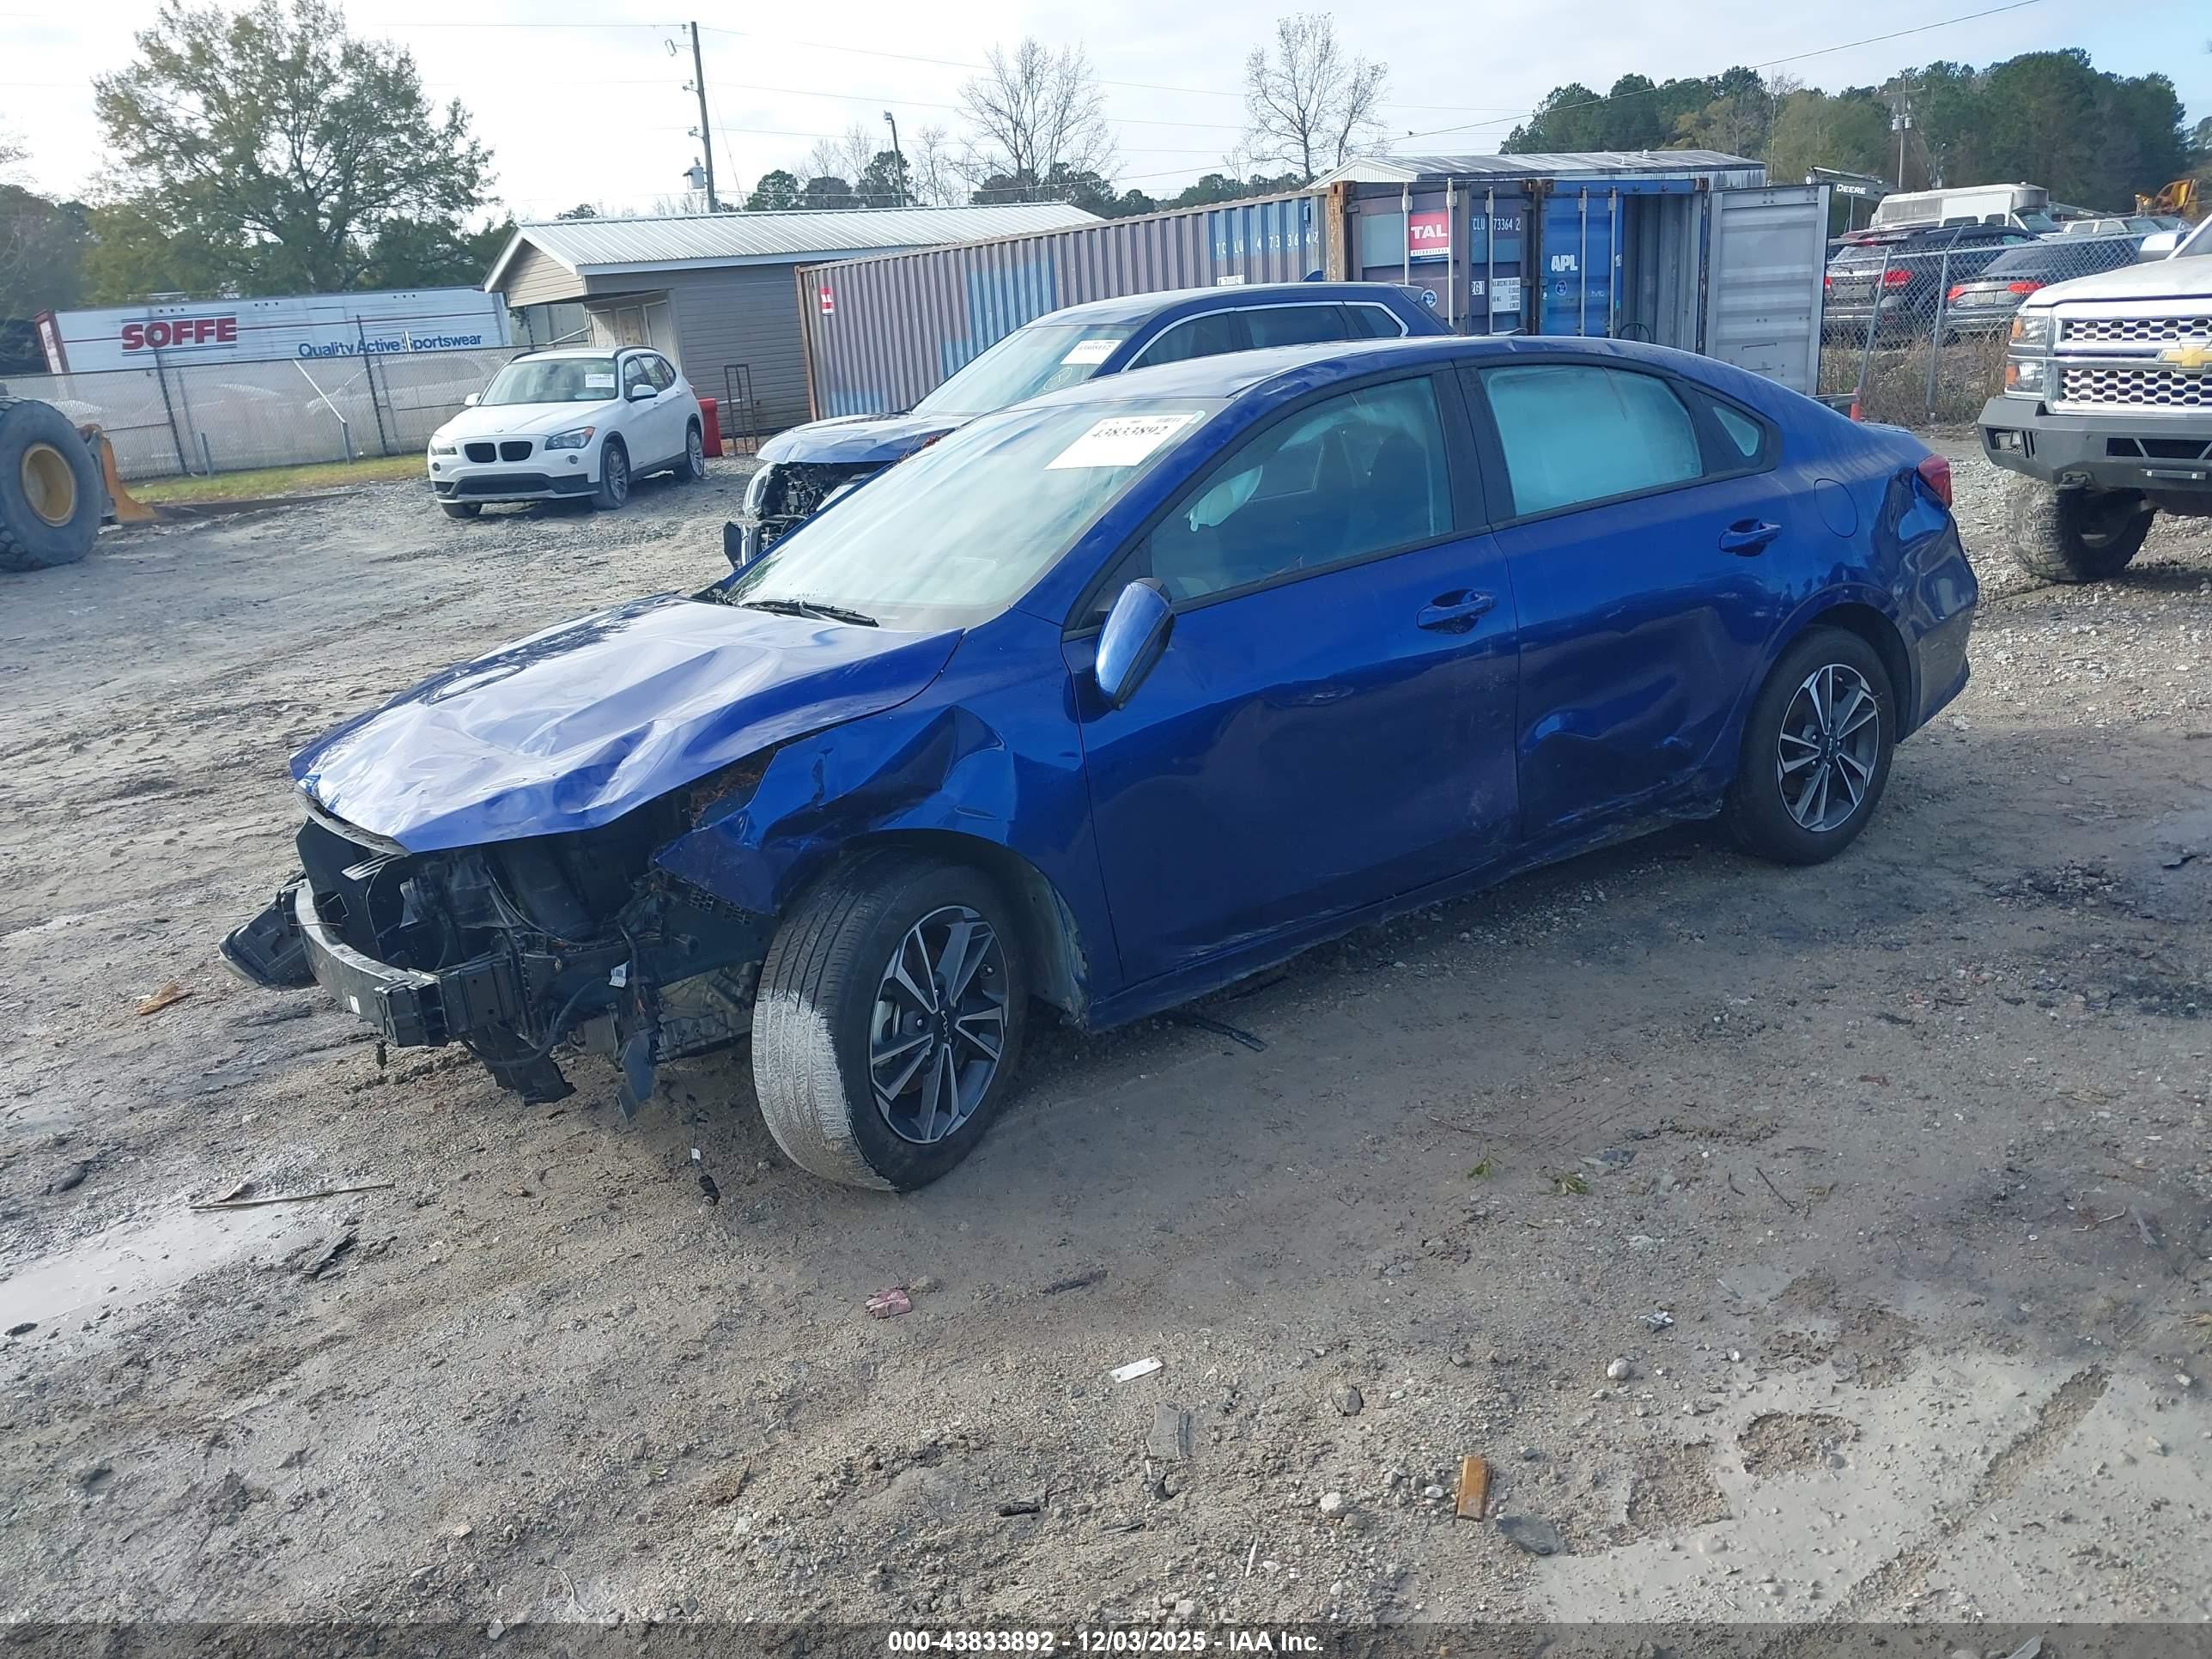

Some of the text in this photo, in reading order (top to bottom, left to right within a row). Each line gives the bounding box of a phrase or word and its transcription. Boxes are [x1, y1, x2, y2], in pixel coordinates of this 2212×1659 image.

[1836, 184, 1866, 195] DEERE
[1411, 224, 1448, 240] TAL
[1471, 217, 1486, 231] CLU
[1551, 254, 1578, 271] APL
[122, 318, 237, 350] SOFFE
[298, 342, 354, 357] Quality
[356, 338, 400, 354] Active
